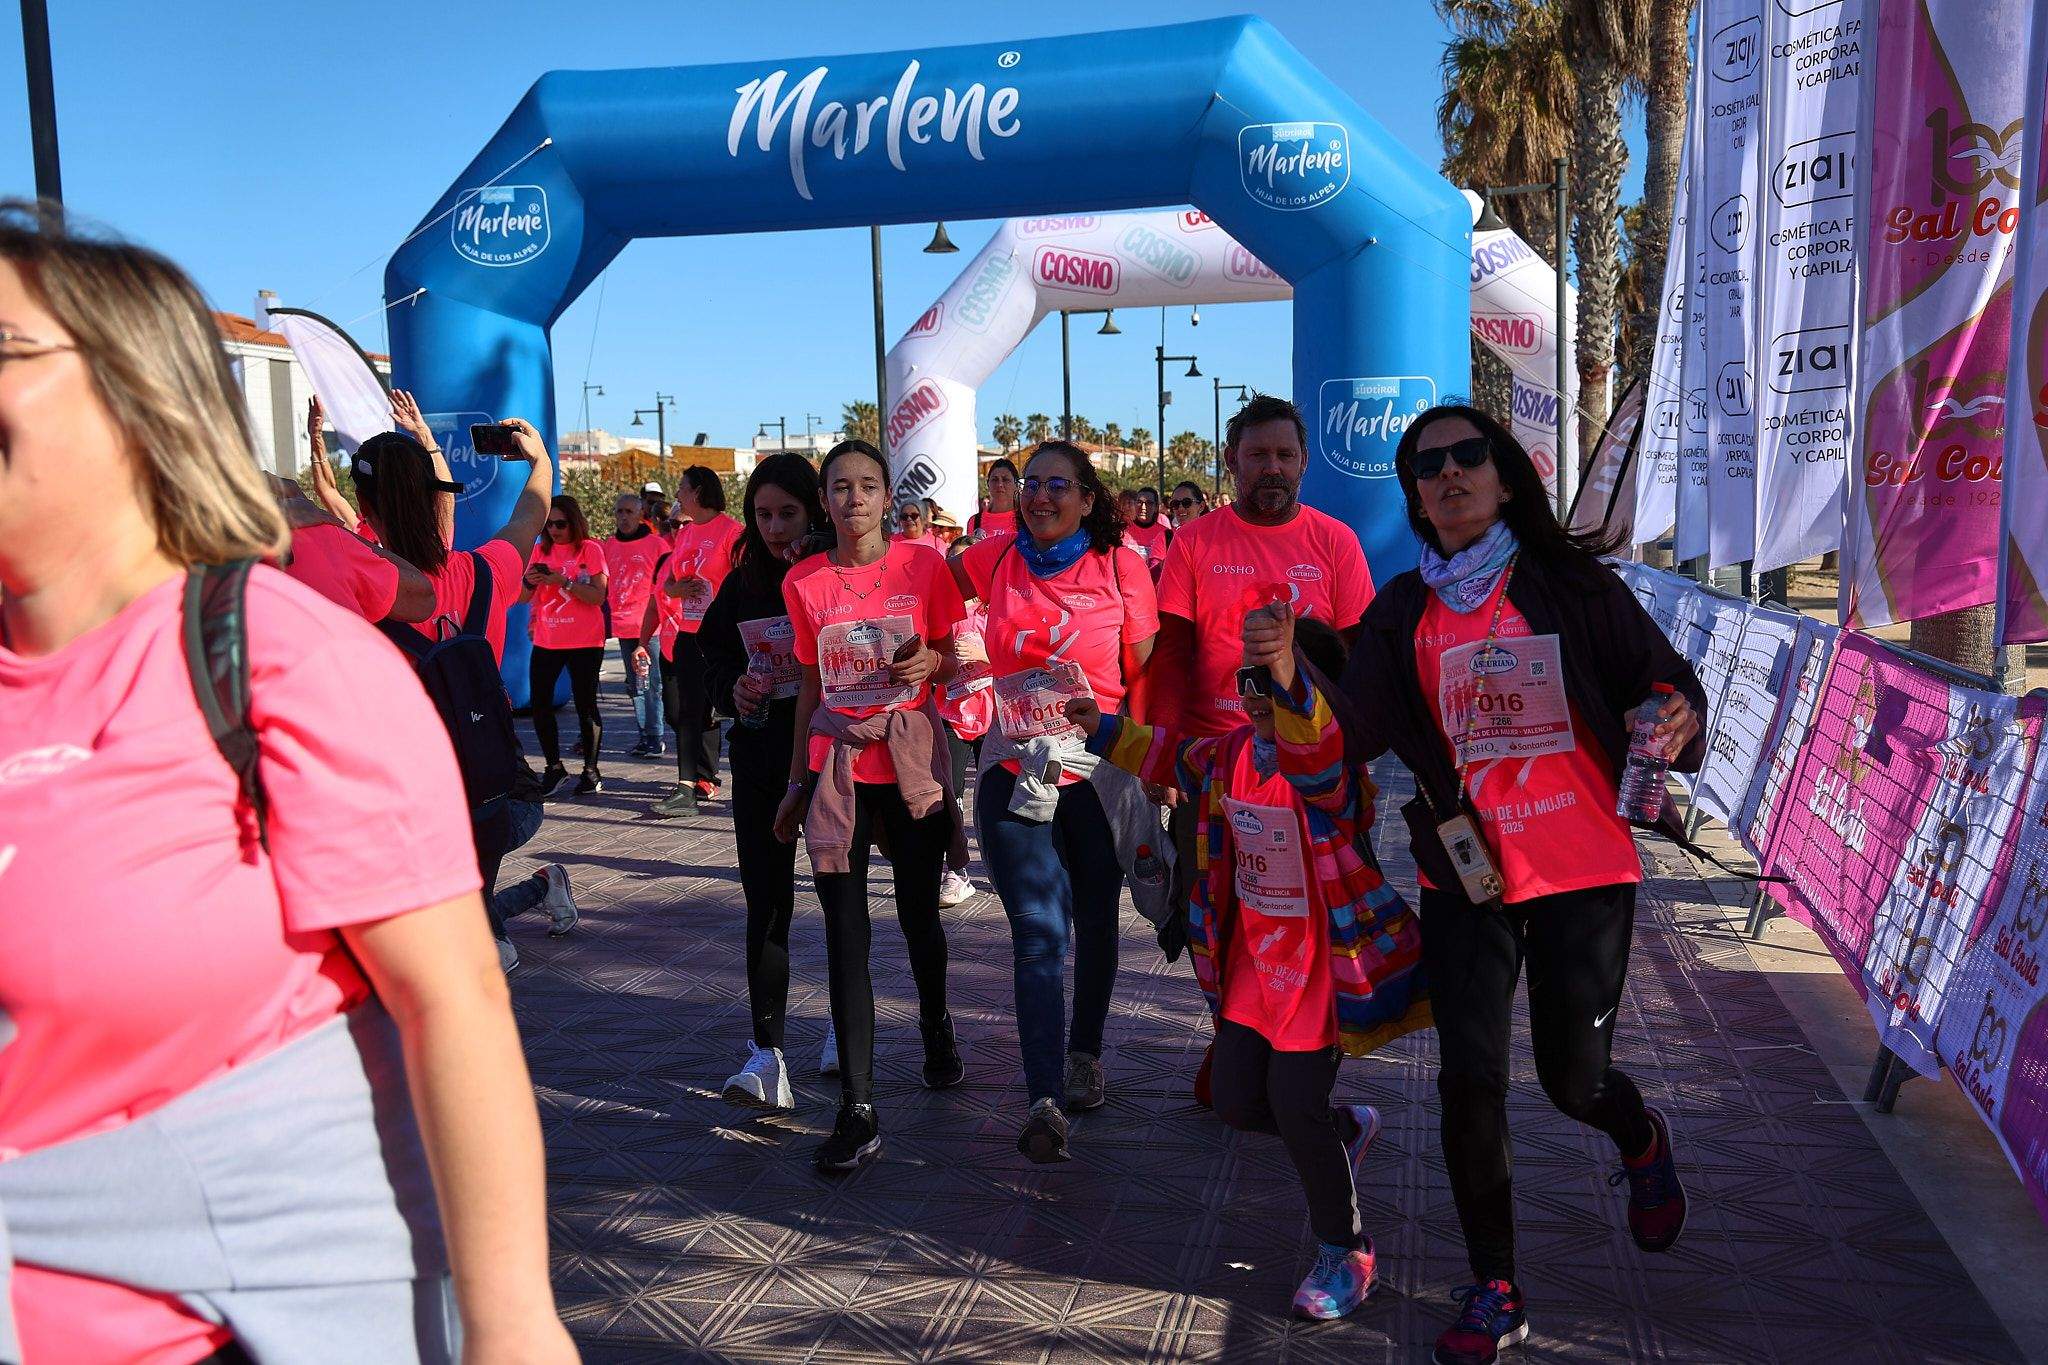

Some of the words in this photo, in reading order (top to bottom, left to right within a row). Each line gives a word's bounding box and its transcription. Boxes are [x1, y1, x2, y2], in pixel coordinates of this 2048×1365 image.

[1771, 25, 1843, 59] COSMÉTICA
[727, 59, 1021, 200] Marlene
[1248, 139, 1343, 189] Marlene
[1785, 152, 1855, 190] ziaj
[1255, 187, 1273, 203] HIJA
[1275, 196, 1288, 206] DE
[1289, 195, 1307, 206] LOS
[1308, 181, 1336, 203] ALPES
[457, 203, 543, 245] Marlene
[1884, 200, 1962, 245] Sal
[480, 252, 493, 261] DE
[494, 253, 512, 262] LOS
[513, 242, 538, 260] ALPES
[1122, 226, 1195, 282] COSMO
[1926, 248, 1991, 267] Desde
[1040, 251, 1114, 291] COSMO
[959, 253, 1015, 327] COSMO
[886, 385, 941, 448] COSMO
[1330, 449, 1350, 468] HIJA
[1352, 461, 1366, 472] DE
[1368, 462, 1389, 472] LOS
[1213, 564, 1255, 576] OYSHO
[816, 604, 853, 620] OYSHO
[853, 657, 888, 673] 016
[1473, 657, 1515, 668] ASURIANA
[834, 694, 864, 703] OYSHO
[1478, 692, 1524, 713] 016
[1517, 739, 1559, 751] Santander
[1496, 806, 1514, 821] DE
[1516, 802, 1533, 819] LA
[1534, 790, 1577, 816] MUJER
[1500, 819, 1525, 835] 2025
[2009, 938, 2041, 988] Costa
